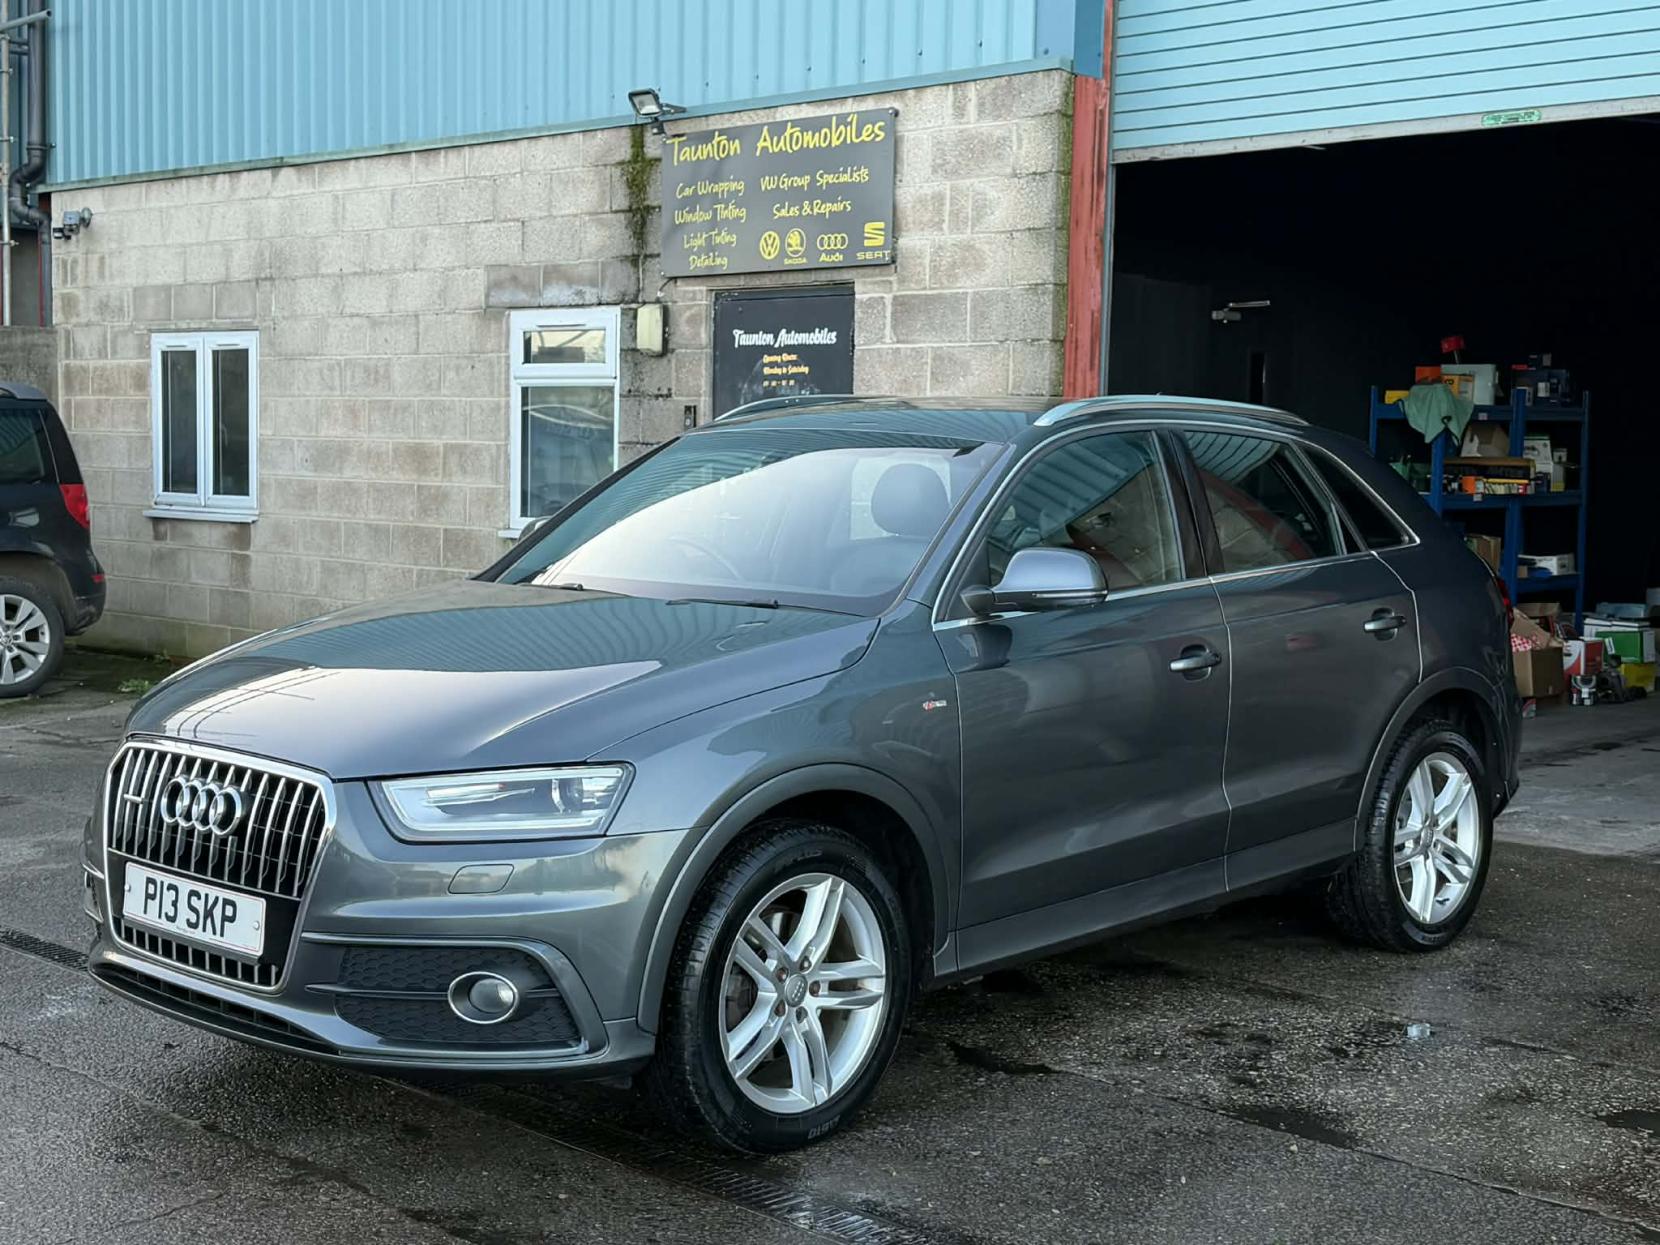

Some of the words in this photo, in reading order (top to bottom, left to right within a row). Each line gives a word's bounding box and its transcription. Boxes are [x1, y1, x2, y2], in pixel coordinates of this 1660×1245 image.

[666, 131, 741, 166] Taunton
[755, 112, 886, 157] Automobiles
[676, 182, 696, 199] Car
[697, 175, 745, 199] Wrapping
[760, 174, 779, 192] VW
[779, 172, 811, 191] Group
[815, 164, 870, 188] Specialists
[674, 203, 713, 225] Window
[713, 200, 747, 223] Tinting
[773, 202, 800, 219] Sales
[802, 200, 813, 217] &
[813, 196, 852, 219] Repairs
[683, 232, 706, 252] Light
[706, 228, 737, 247] Tinting
[688, 252, 729, 270] Detailing
[819, 251, 844, 262] Audi
[855, 249, 891, 261] SEAT
[732, 329, 774, 348] Taunton
[774, 327, 837, 348] Automobiles
[143, 875, 179, 924] P13
[185, 889, 237, 938] SKP
